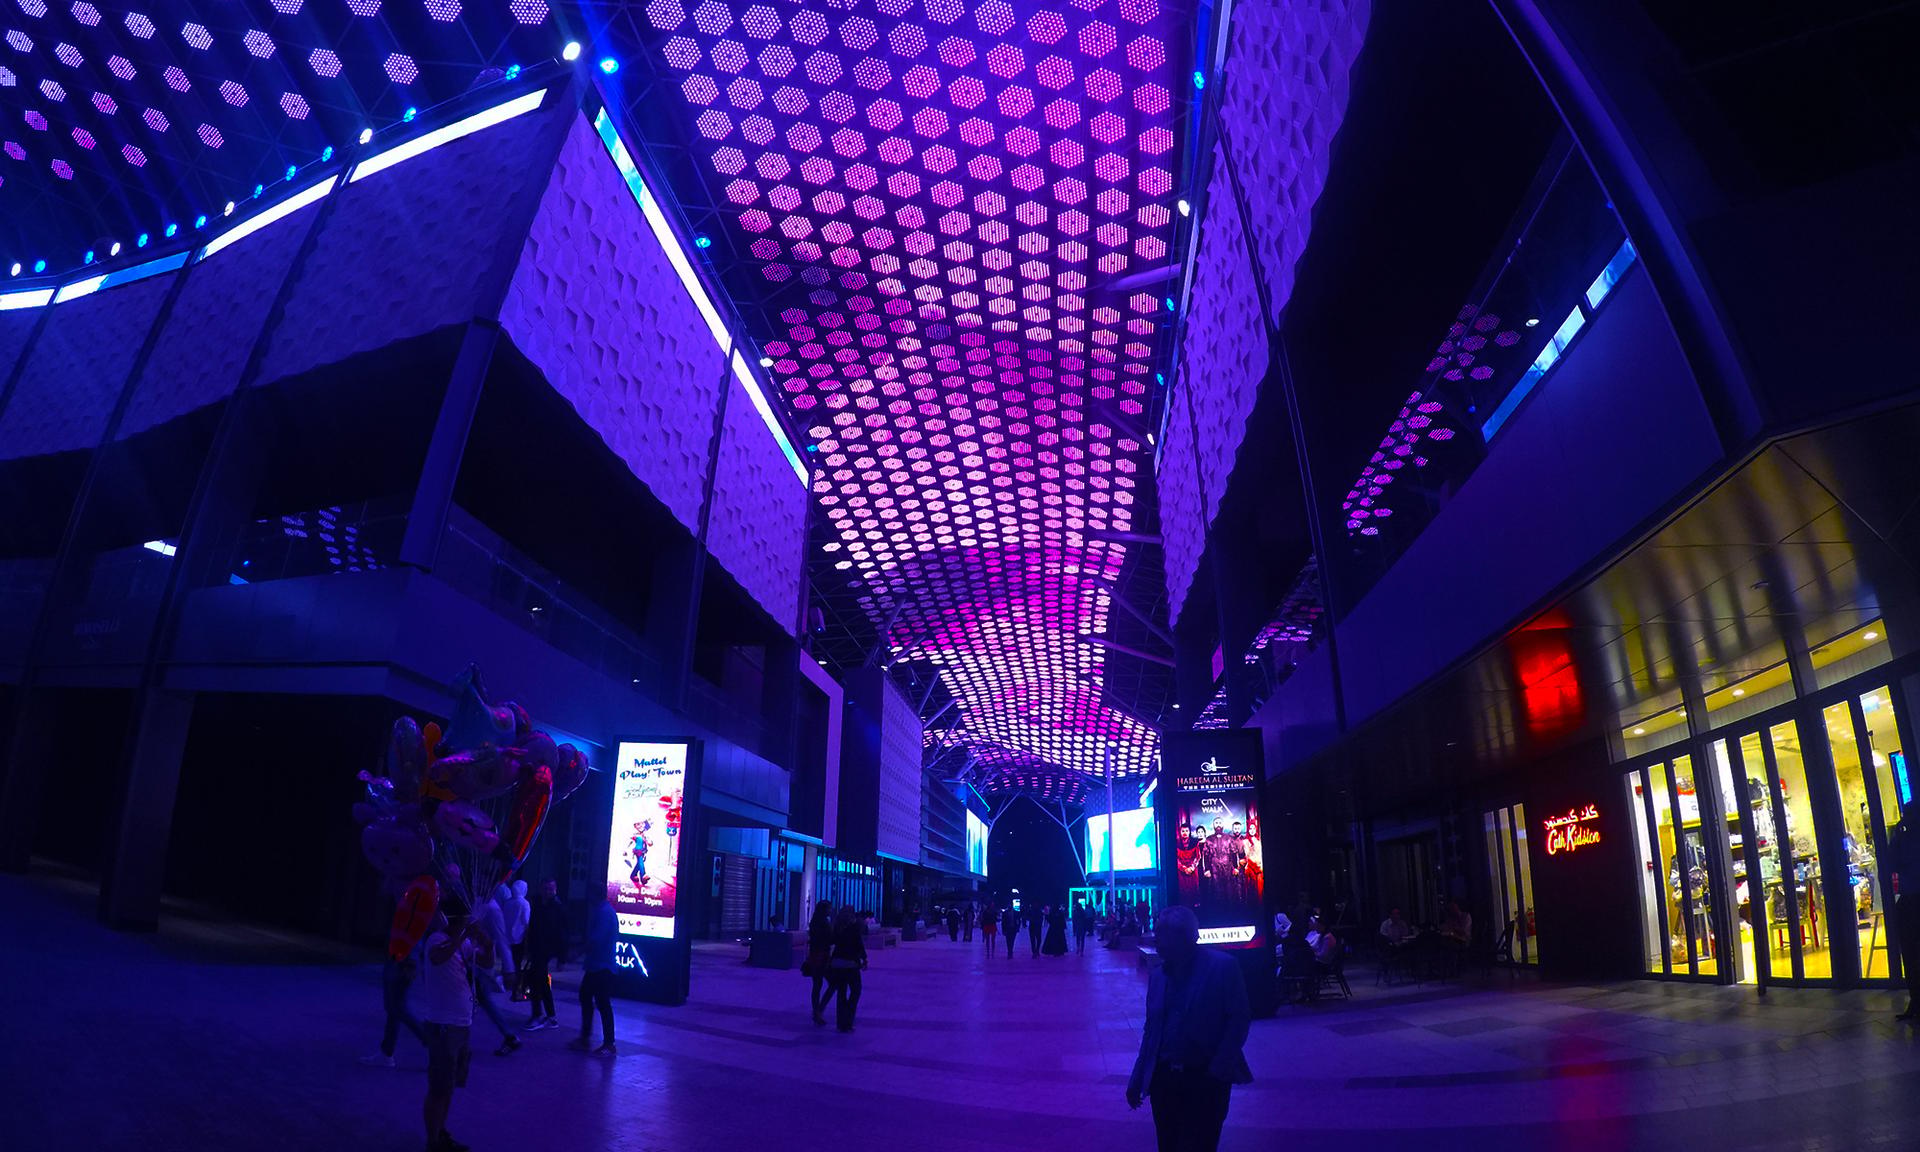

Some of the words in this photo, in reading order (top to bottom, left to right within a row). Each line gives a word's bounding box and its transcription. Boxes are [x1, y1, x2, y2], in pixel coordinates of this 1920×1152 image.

[634, 756, 667, 768] Mattel
[620, 769, 650, 780] Play!
[653, 767, 682, 778] Town
[1177, 776, 1210, 787] HAREEM
[1223, 774, 1254, 784] SULTAN
[1201, 798, 1218, 806] CITY
[1201, 806, 1224, 814] WALK
[1547, 829, 1566, 855] Cath
[1566, 824, 1601, 852] Kidston
[620, 886, 639, 895] Open
[617, 894, 637, 904] 10am
[644, 897, 663, 907] 10pm
[1199, 931, 1219, 940] OW
[615, 955, 635, 968] ALK
